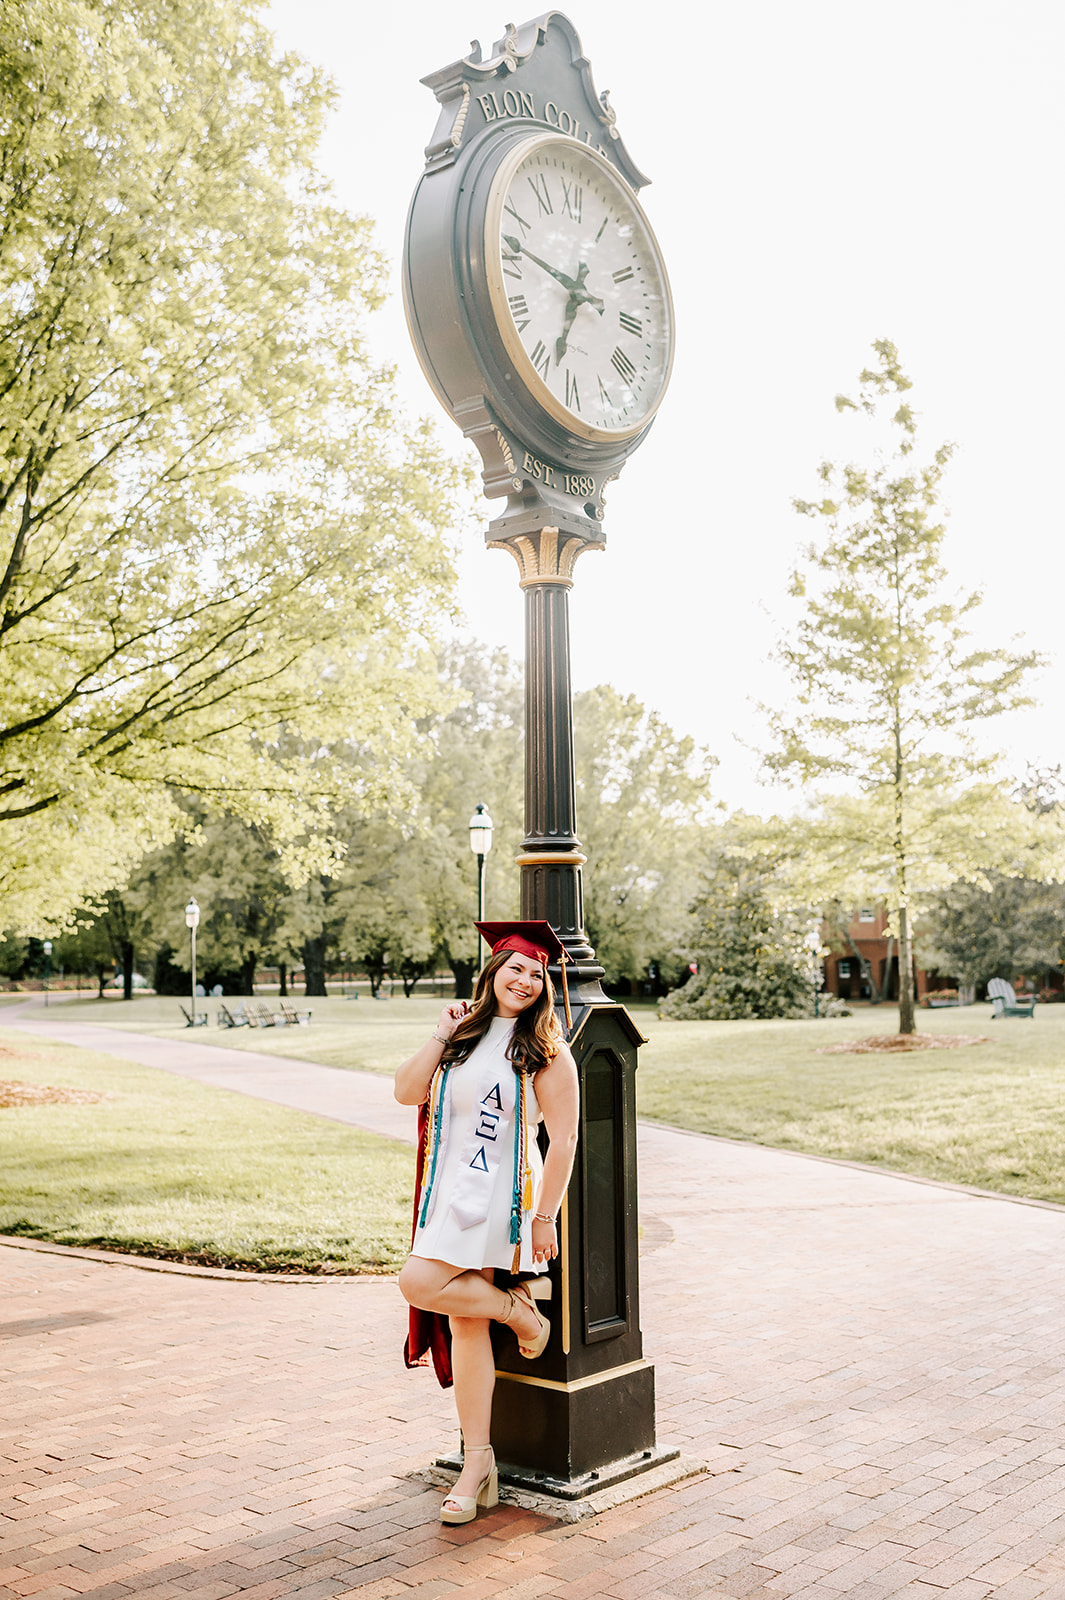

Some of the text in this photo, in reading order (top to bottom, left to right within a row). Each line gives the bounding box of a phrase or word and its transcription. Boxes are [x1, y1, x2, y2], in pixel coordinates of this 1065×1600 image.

[476, 90, 536, 123] ELON
[503, 195, 532, 239] X
[527, 173, 554, 219] XI
[560, 176, 583, 224] XII
[612, 266, 634, 284] II
[619, 311, 642, 338] III
[565, 368, 582, 413] VI
[522, 450, 595, 497] EST. 1889
